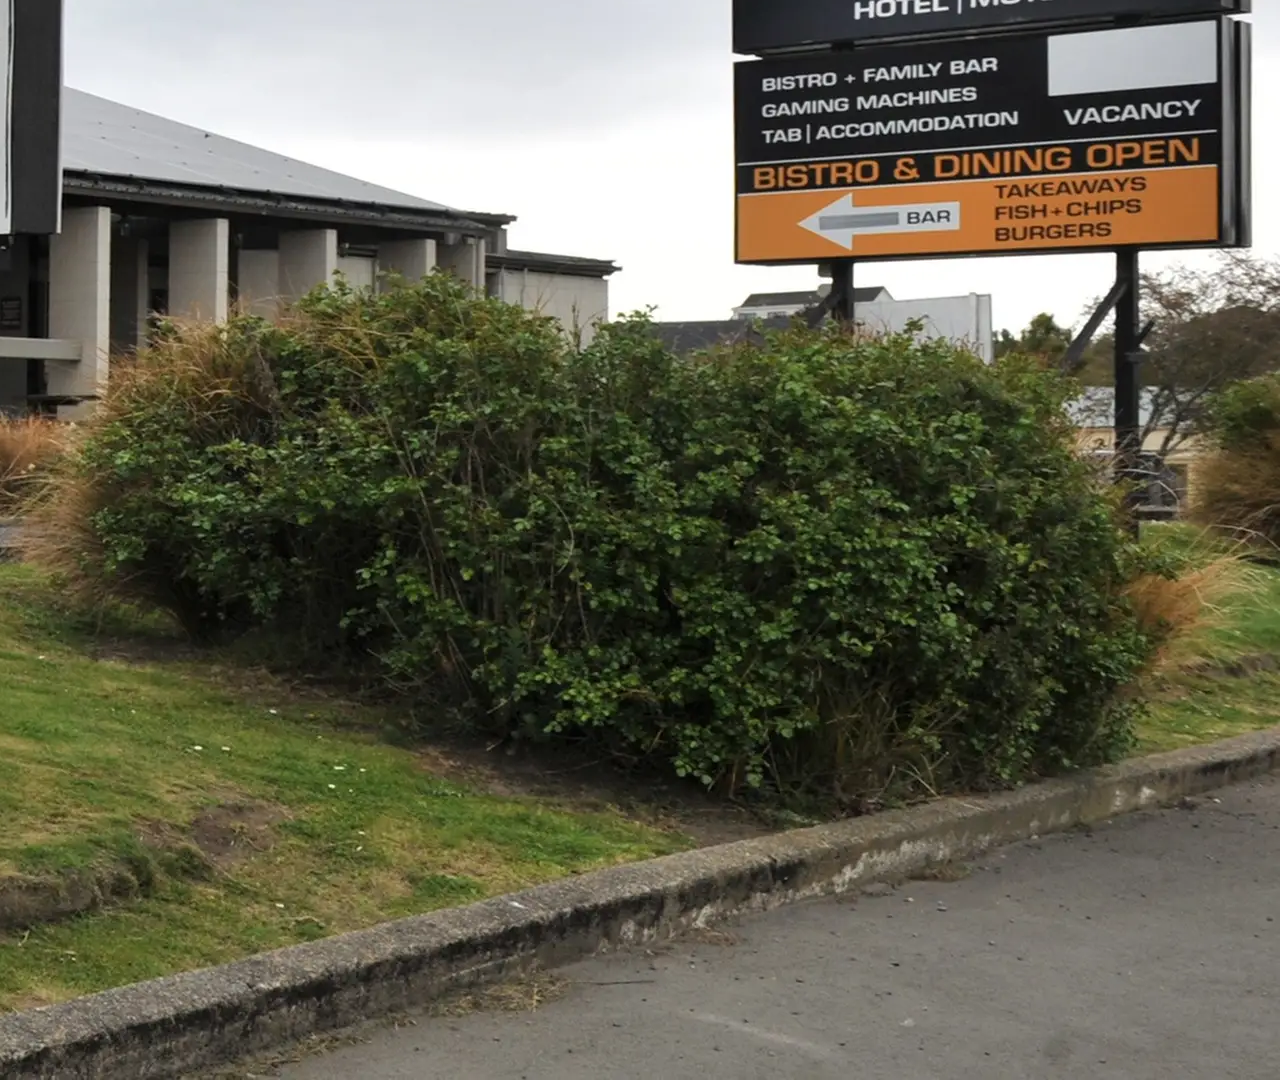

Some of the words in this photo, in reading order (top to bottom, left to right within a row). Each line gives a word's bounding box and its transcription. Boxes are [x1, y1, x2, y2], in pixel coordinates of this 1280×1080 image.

[762, 72, 837, 92] BISTRO
[863, 62, 943, 83] FAMILY
[950, 57, 998, 75] BAR
[762, 98, 849, 118] GAMING
[857, 87, 977, 110] MACHINES
[1063, 99, 1202, 125] VACANCY
[762, 128, 802, 143] TAB
[815, 111, 1019, 140] ACCOMMODATION
[753, 160, 880, 190] BISTRO
[893, 157, 920, 180] &
[934, 147, 1072, 178] DINING
[1087, 138, 1200, 168] OPEN
[994, 176, 1147, 199] TAKEAWAYS
[906, 210, 951, 225] BAR
[995, 222, 1111, 242] BURGERS
